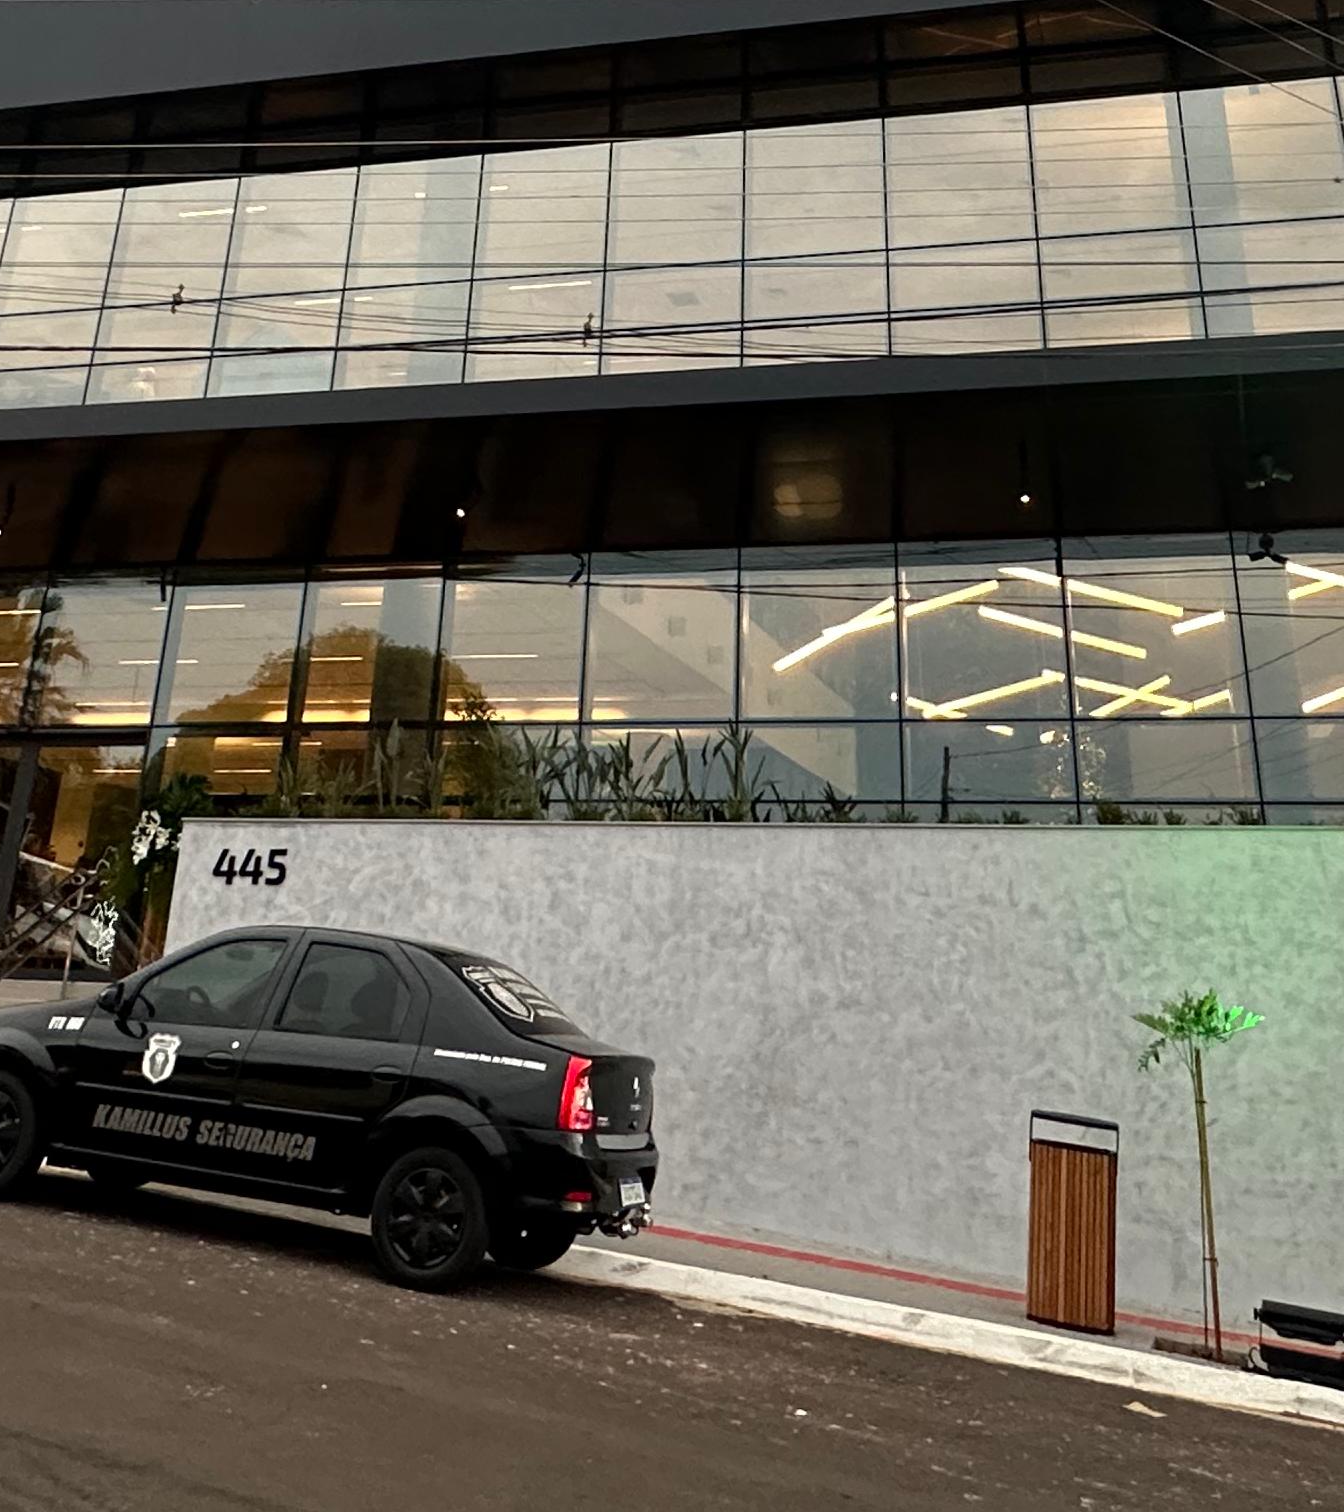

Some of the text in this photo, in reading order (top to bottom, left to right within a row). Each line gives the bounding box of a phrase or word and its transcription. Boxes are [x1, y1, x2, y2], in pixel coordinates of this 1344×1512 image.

[212, 848, 288, 886] 445
[92, 1104, 317, 1162] KAMILLUS SEGURANÇA
